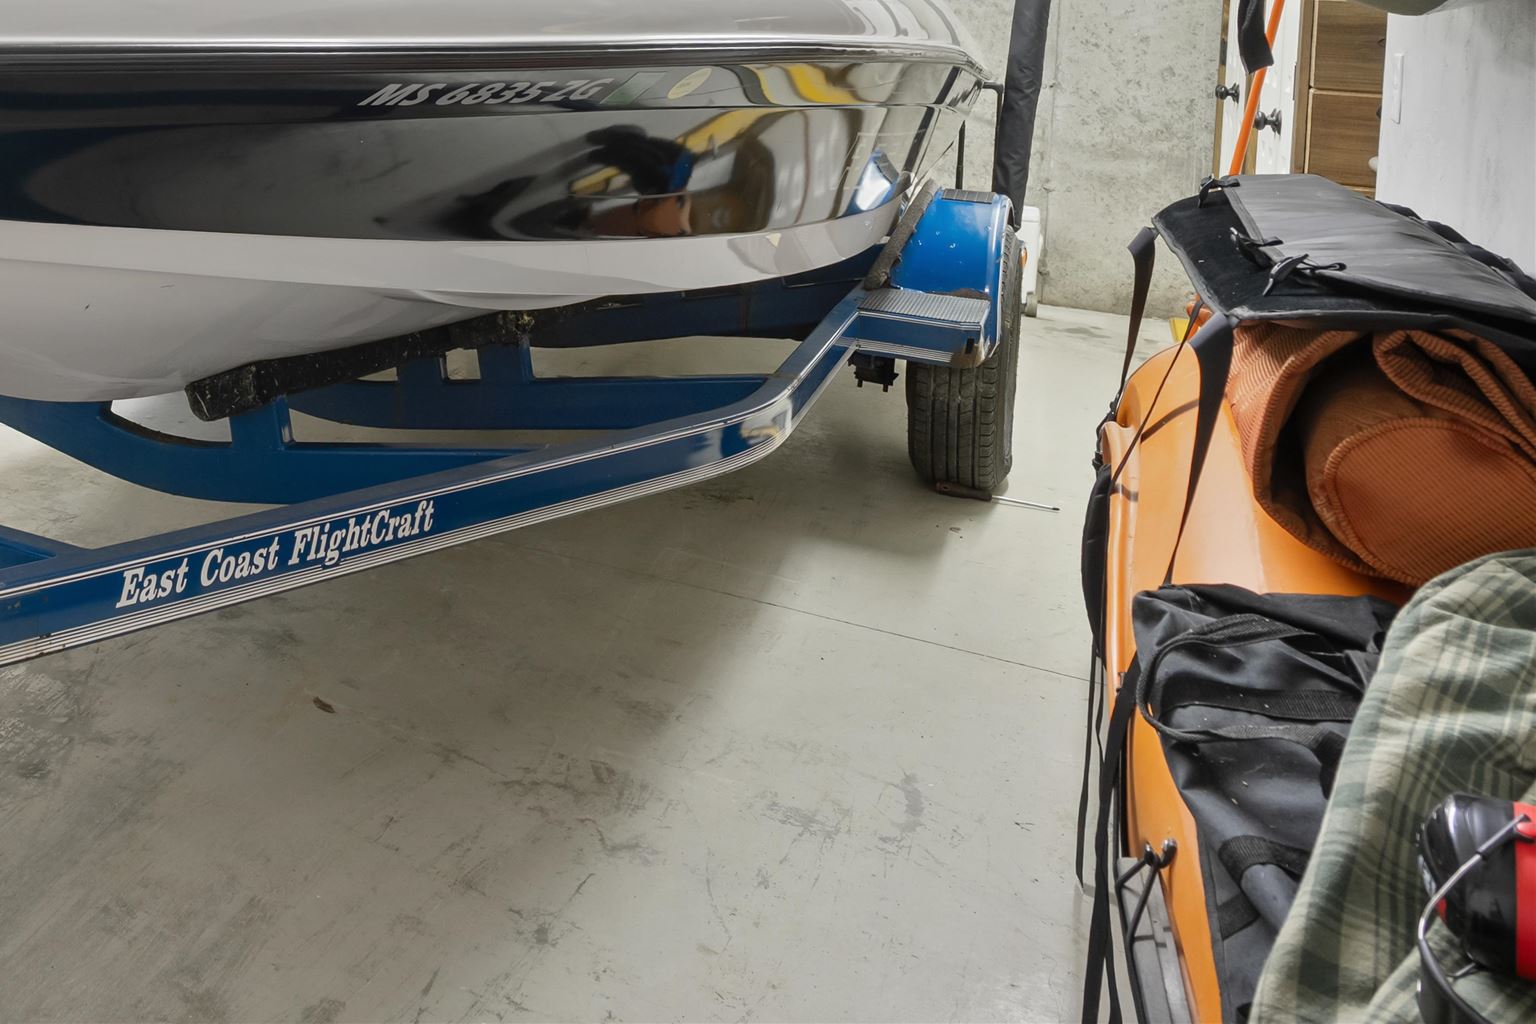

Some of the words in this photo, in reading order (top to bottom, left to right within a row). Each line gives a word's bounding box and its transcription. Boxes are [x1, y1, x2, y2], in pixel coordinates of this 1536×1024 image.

[357, 82, 447, 106] MS
[435, 80, 557, 106] 6835
[539, 77, 615, 103] ZG
[115, 557, 189, 608] East
[200, 535, 280, 587] Coast
[288, 499, 434, 566] FlightCraft
